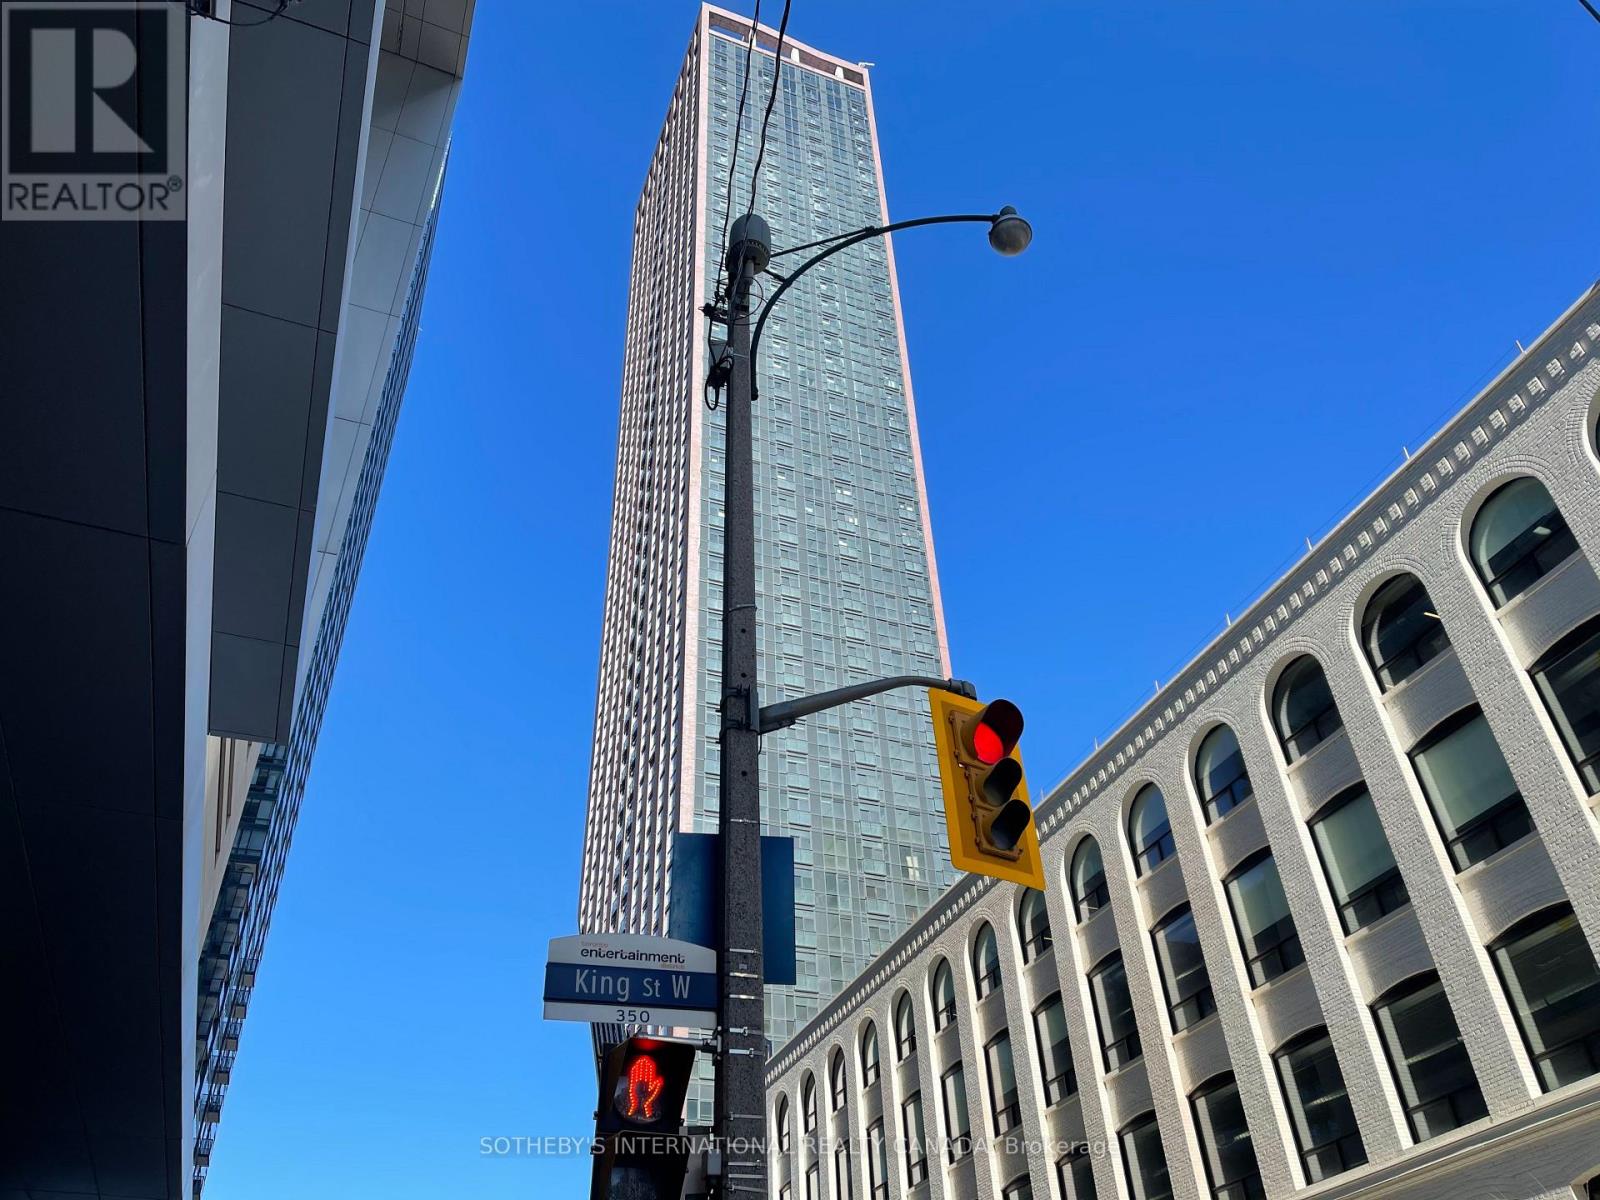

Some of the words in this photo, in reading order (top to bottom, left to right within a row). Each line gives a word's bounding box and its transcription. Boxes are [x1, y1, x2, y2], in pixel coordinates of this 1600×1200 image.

[580, 947, 686, 964] entertainment
[575, 968, 630, 1002] King
[642, 977, 661, 998] St
[671, 974, 691, 999] W
[615, 1009, 650, 1023] 350
